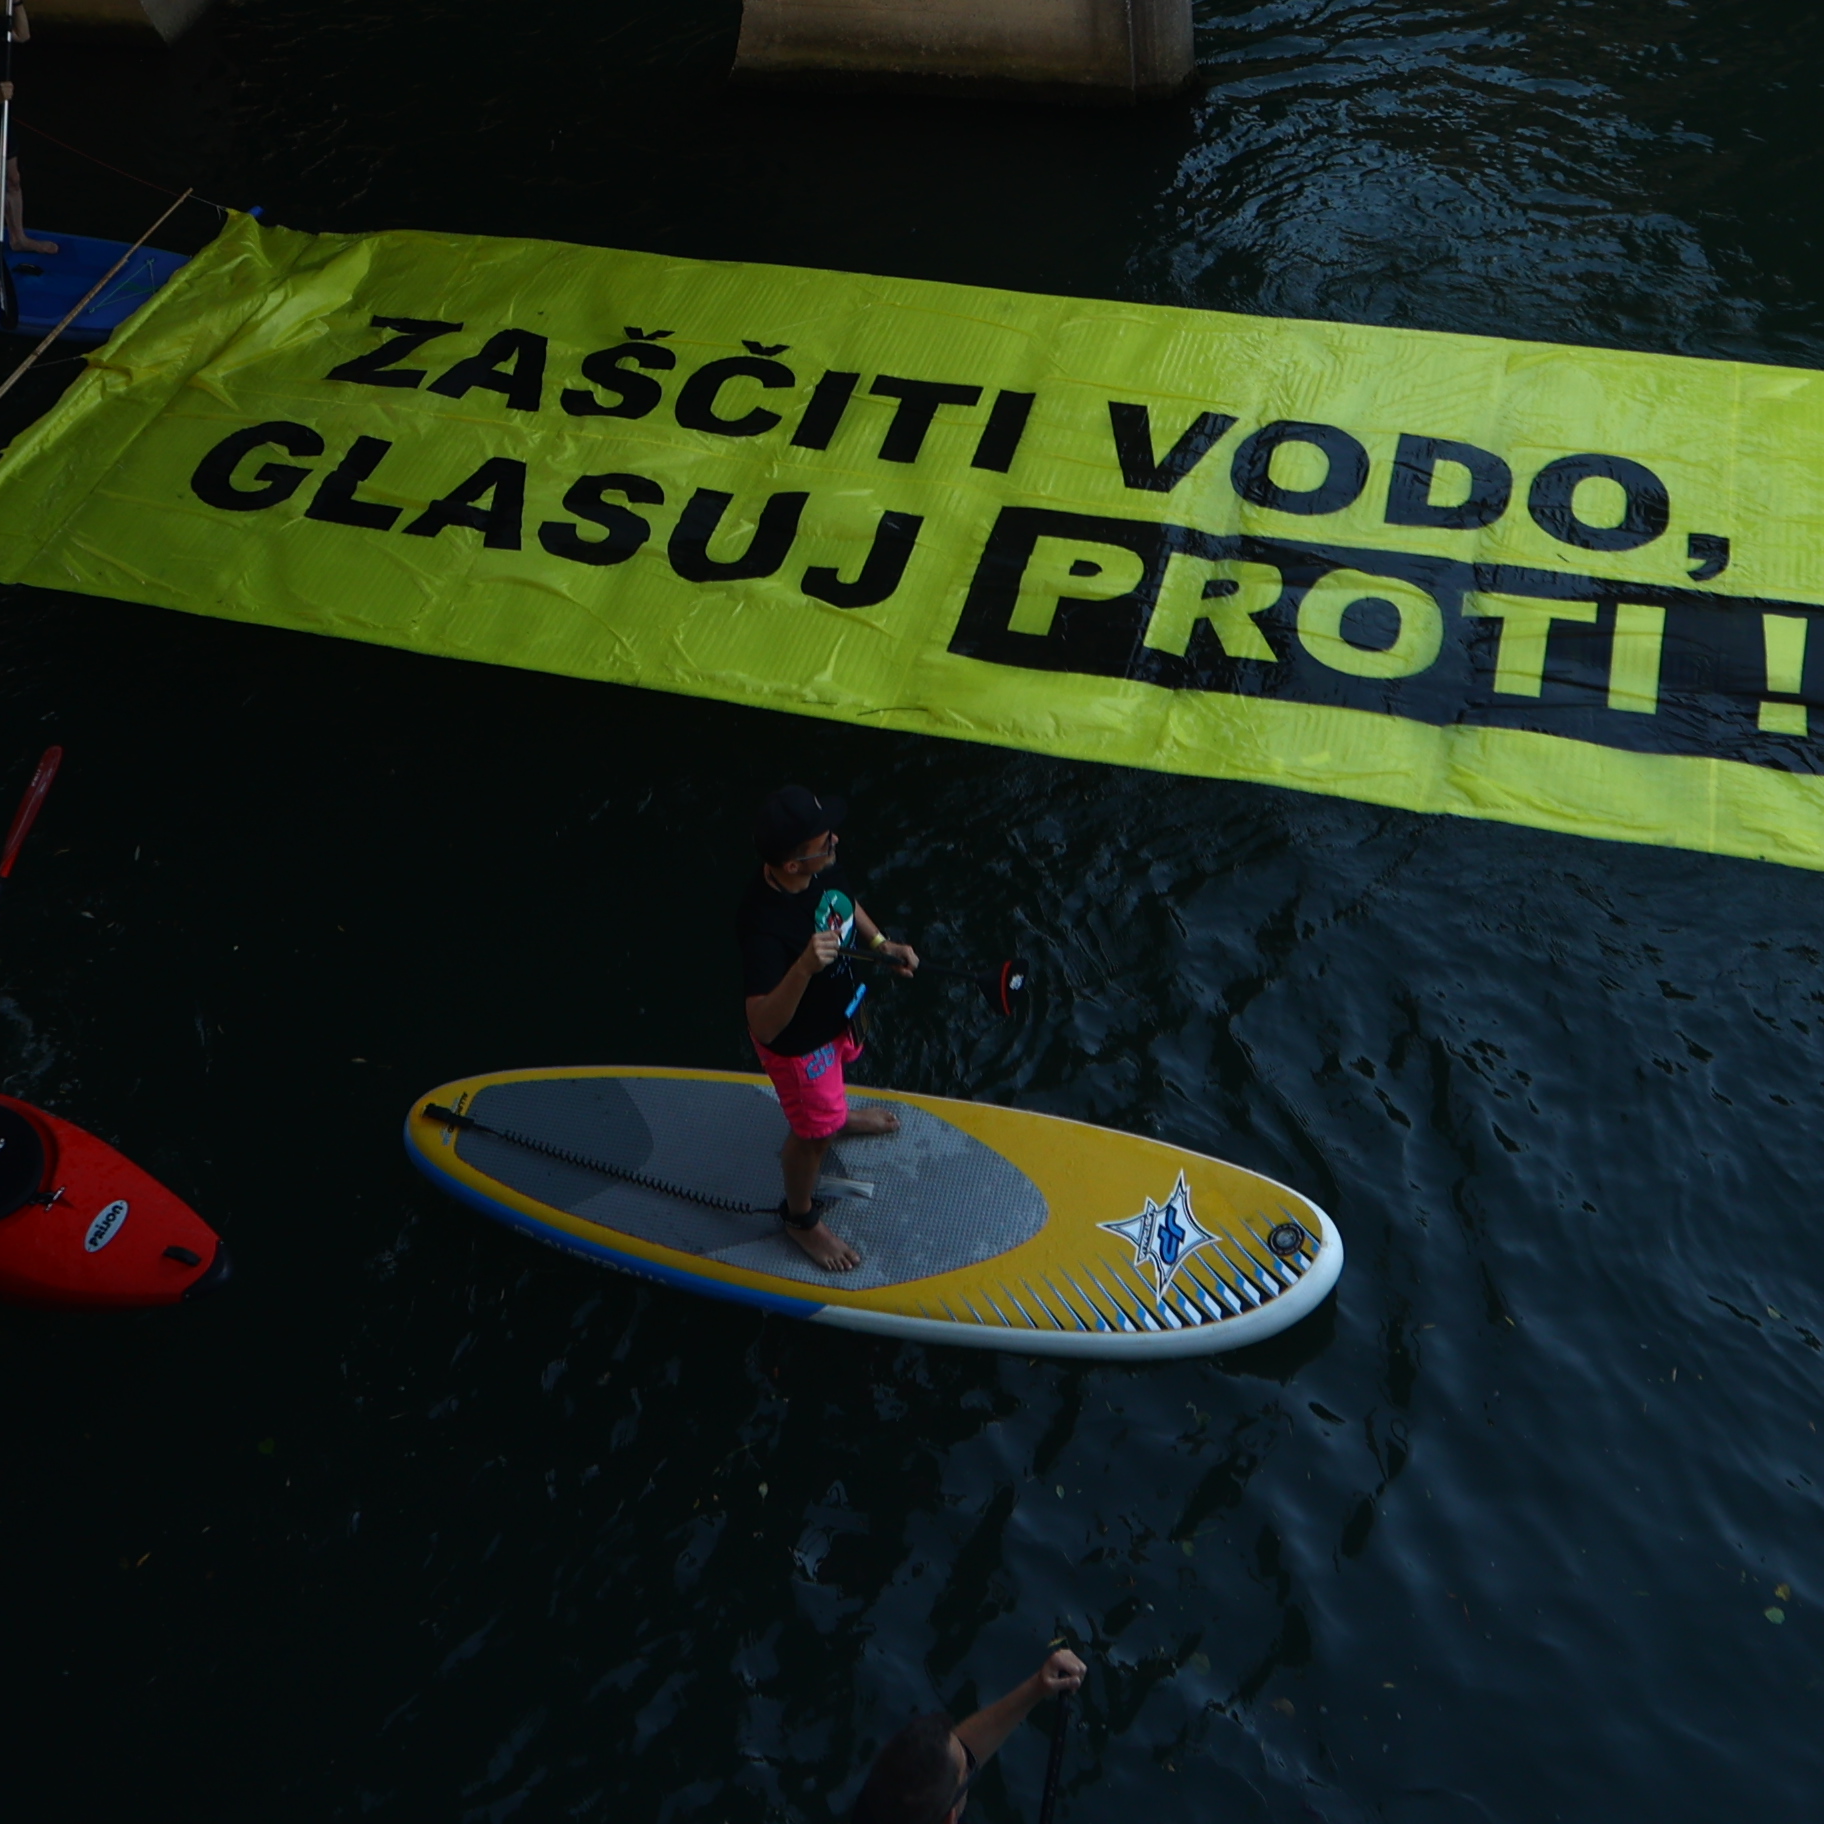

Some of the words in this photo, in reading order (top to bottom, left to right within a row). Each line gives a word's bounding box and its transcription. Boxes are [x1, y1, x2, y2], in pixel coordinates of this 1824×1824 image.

[187, 419, 925, 609] GLASUJ
[1006, 534, 1667, 716] PROTI
[326, 312, 1036, 474] ZAŠČITI
[1107, 400, 1731, 583] VODO,
